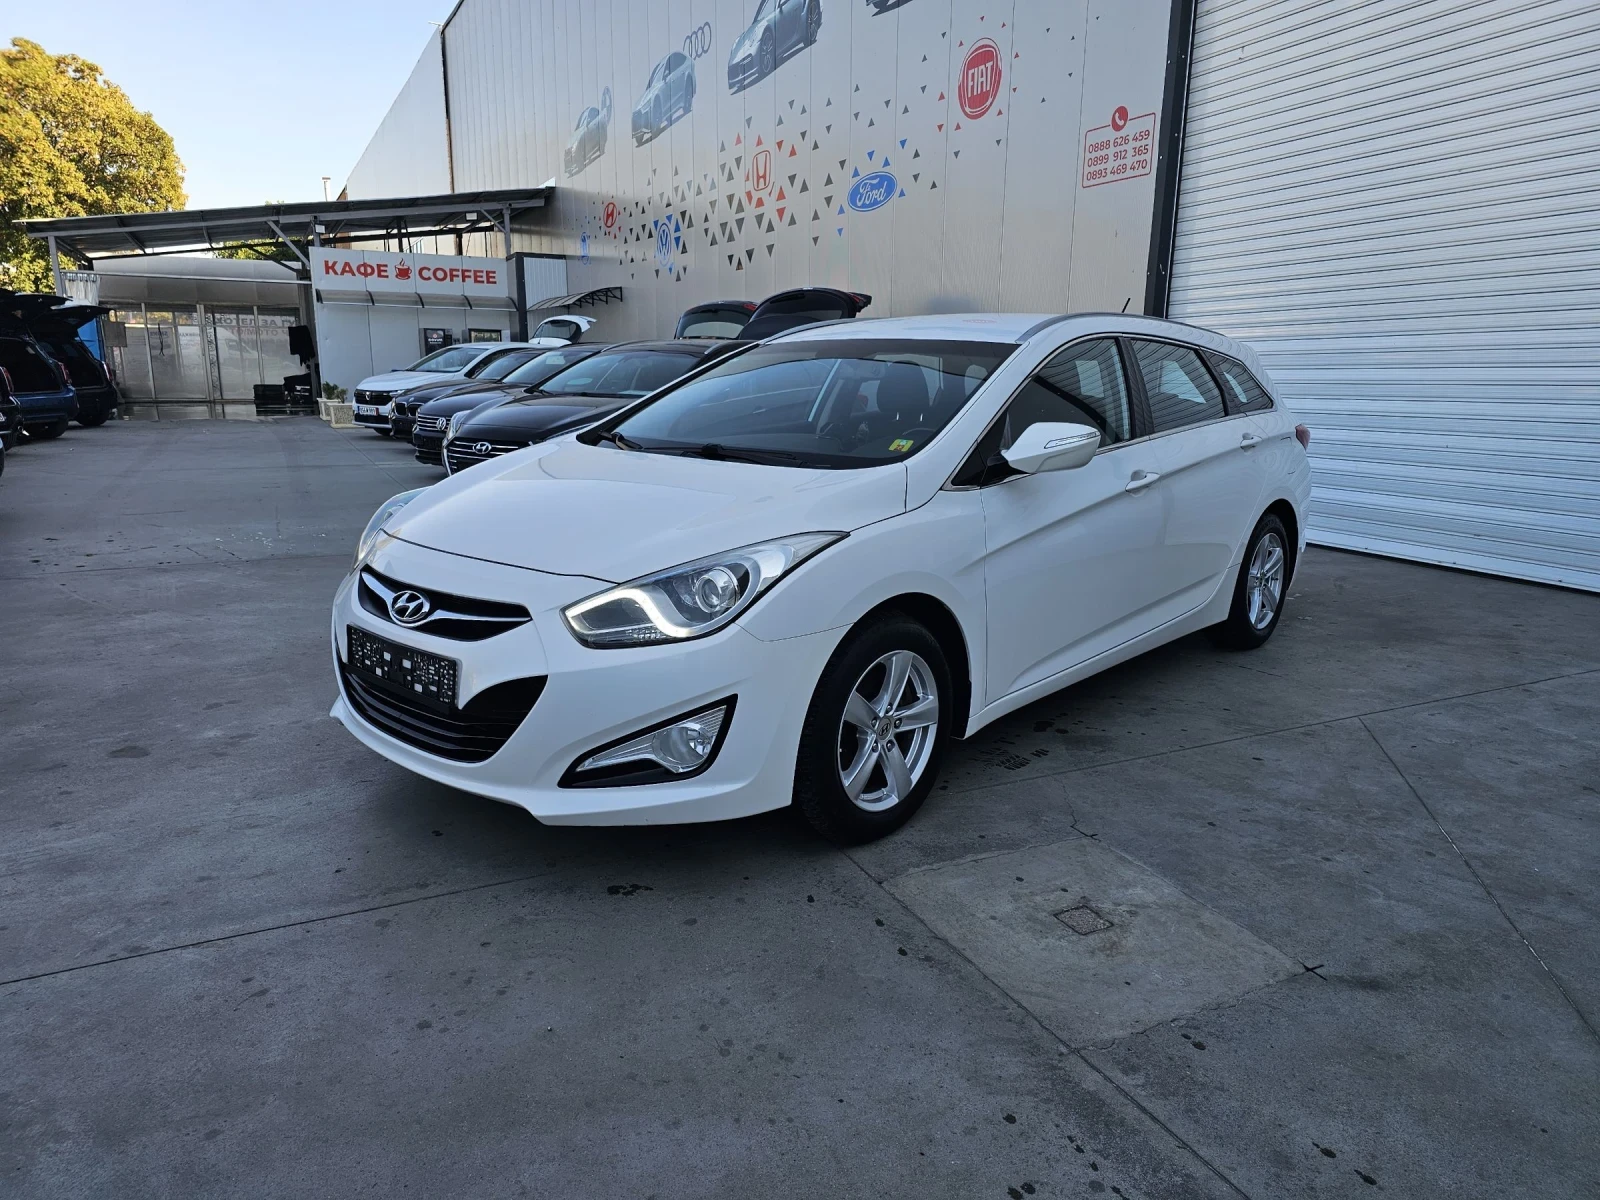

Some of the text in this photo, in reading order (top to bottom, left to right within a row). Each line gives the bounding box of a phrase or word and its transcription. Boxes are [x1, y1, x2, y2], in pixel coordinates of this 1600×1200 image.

[967, 60, 993, 98] FIAT
[1088, 129, 1150, 154] 0888 626 459
[1087, 144, 1149, 168] 0899 912 365
[1086, 159, 1148, 181] 0893 469 470
[856, 177, 888, 207] Ford
[323, 259, 389, 279] КАФЕ
[418, 266, 498, 285] COFFEE
